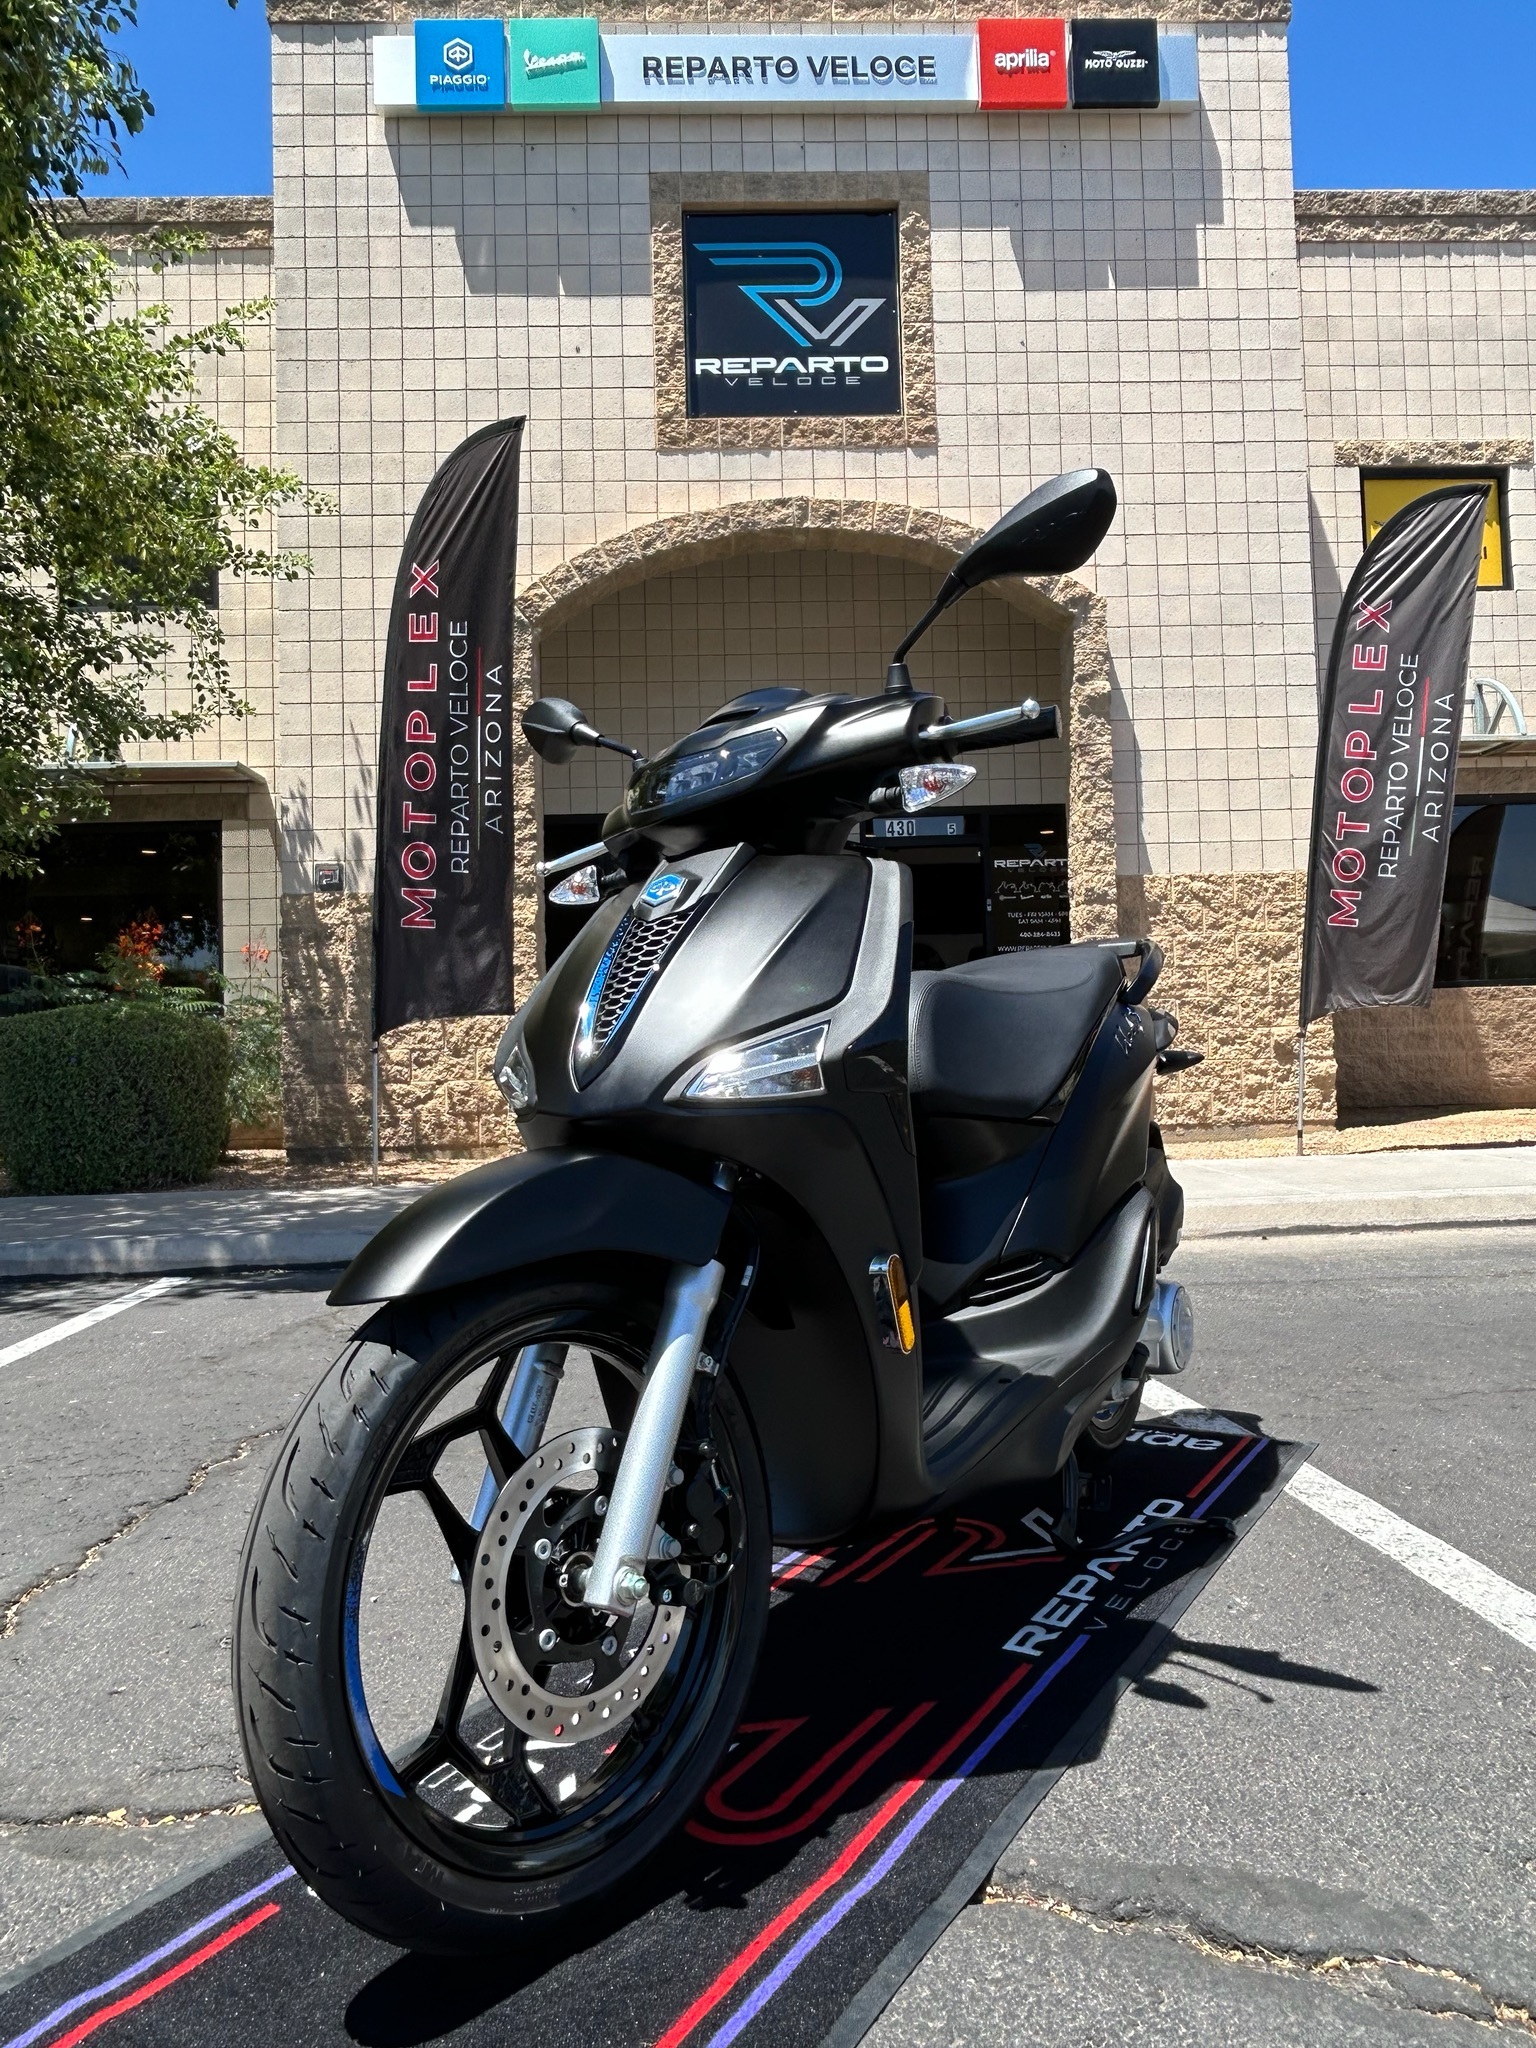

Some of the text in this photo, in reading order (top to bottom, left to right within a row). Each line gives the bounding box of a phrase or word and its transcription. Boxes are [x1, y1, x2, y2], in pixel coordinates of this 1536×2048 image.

[642, 55, 937, 79] REPARTO VELOCE
[994, 48, 1050, 71] aprilia
[1084, 57, 1146, 69] MOTO GUZZI
[429, 74, 488, 86] PIAGGIO
[695, 355, 889, 375] REPARTO
[724, 375, 861, 387] VELOCE
[400, 559, 440, 929] MOTOPLEX
[449, 620, 470, 874] REPARTO VELOCE
[484, 664, 503, 835] ARIZONA
[1327, 599, 1393, 928] MOTOPLEX
[1377, 653, 1419, 878] REPARTO VELOCE
[1421, 692, 1455, 843] ARIZONA
[886, 820, 956, 837] 430 5
[994, 858, 1068, 868] REPART
